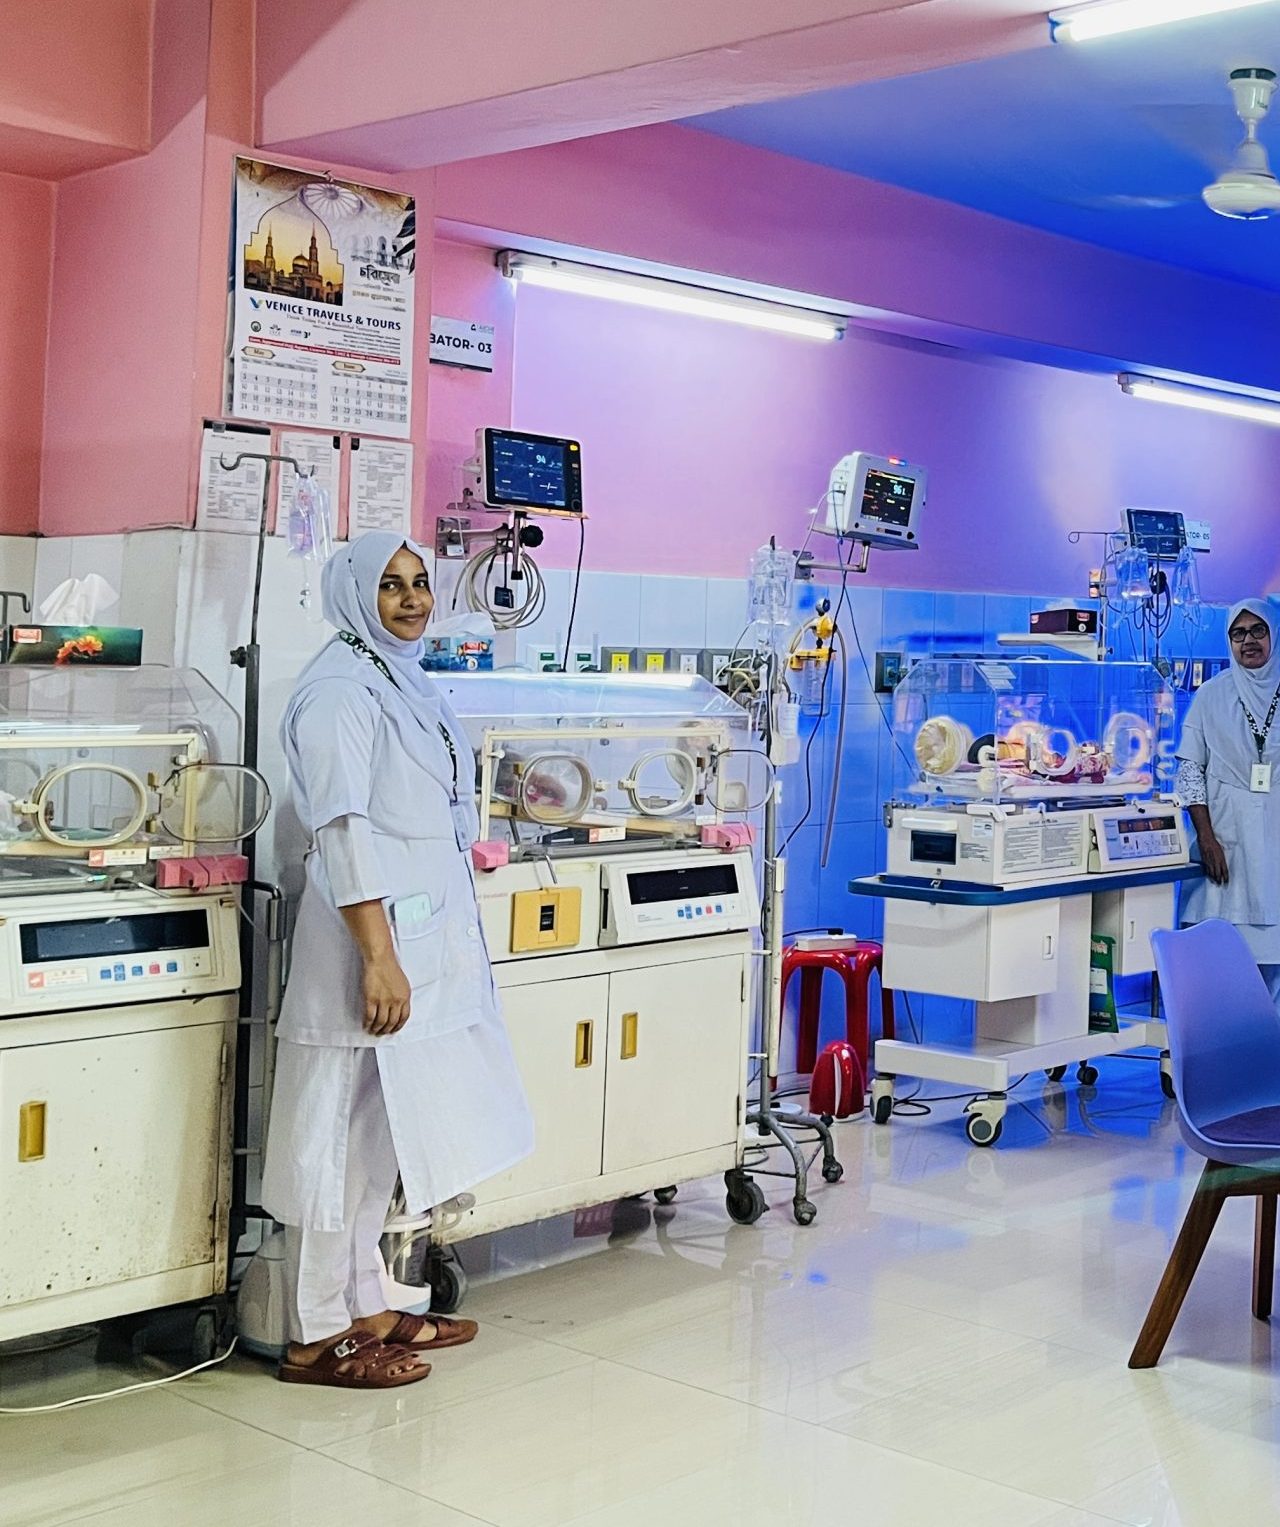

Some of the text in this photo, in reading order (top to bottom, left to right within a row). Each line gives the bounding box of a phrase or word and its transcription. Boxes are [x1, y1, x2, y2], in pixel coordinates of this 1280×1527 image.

[266, 299, 304, 315] VENICE
[307, 307, 353, 323] TRAVELS
[355, 315, 363, 325] &
[367, 317, 401, 331] TOURS
[477, 342, 492, 354] 03
